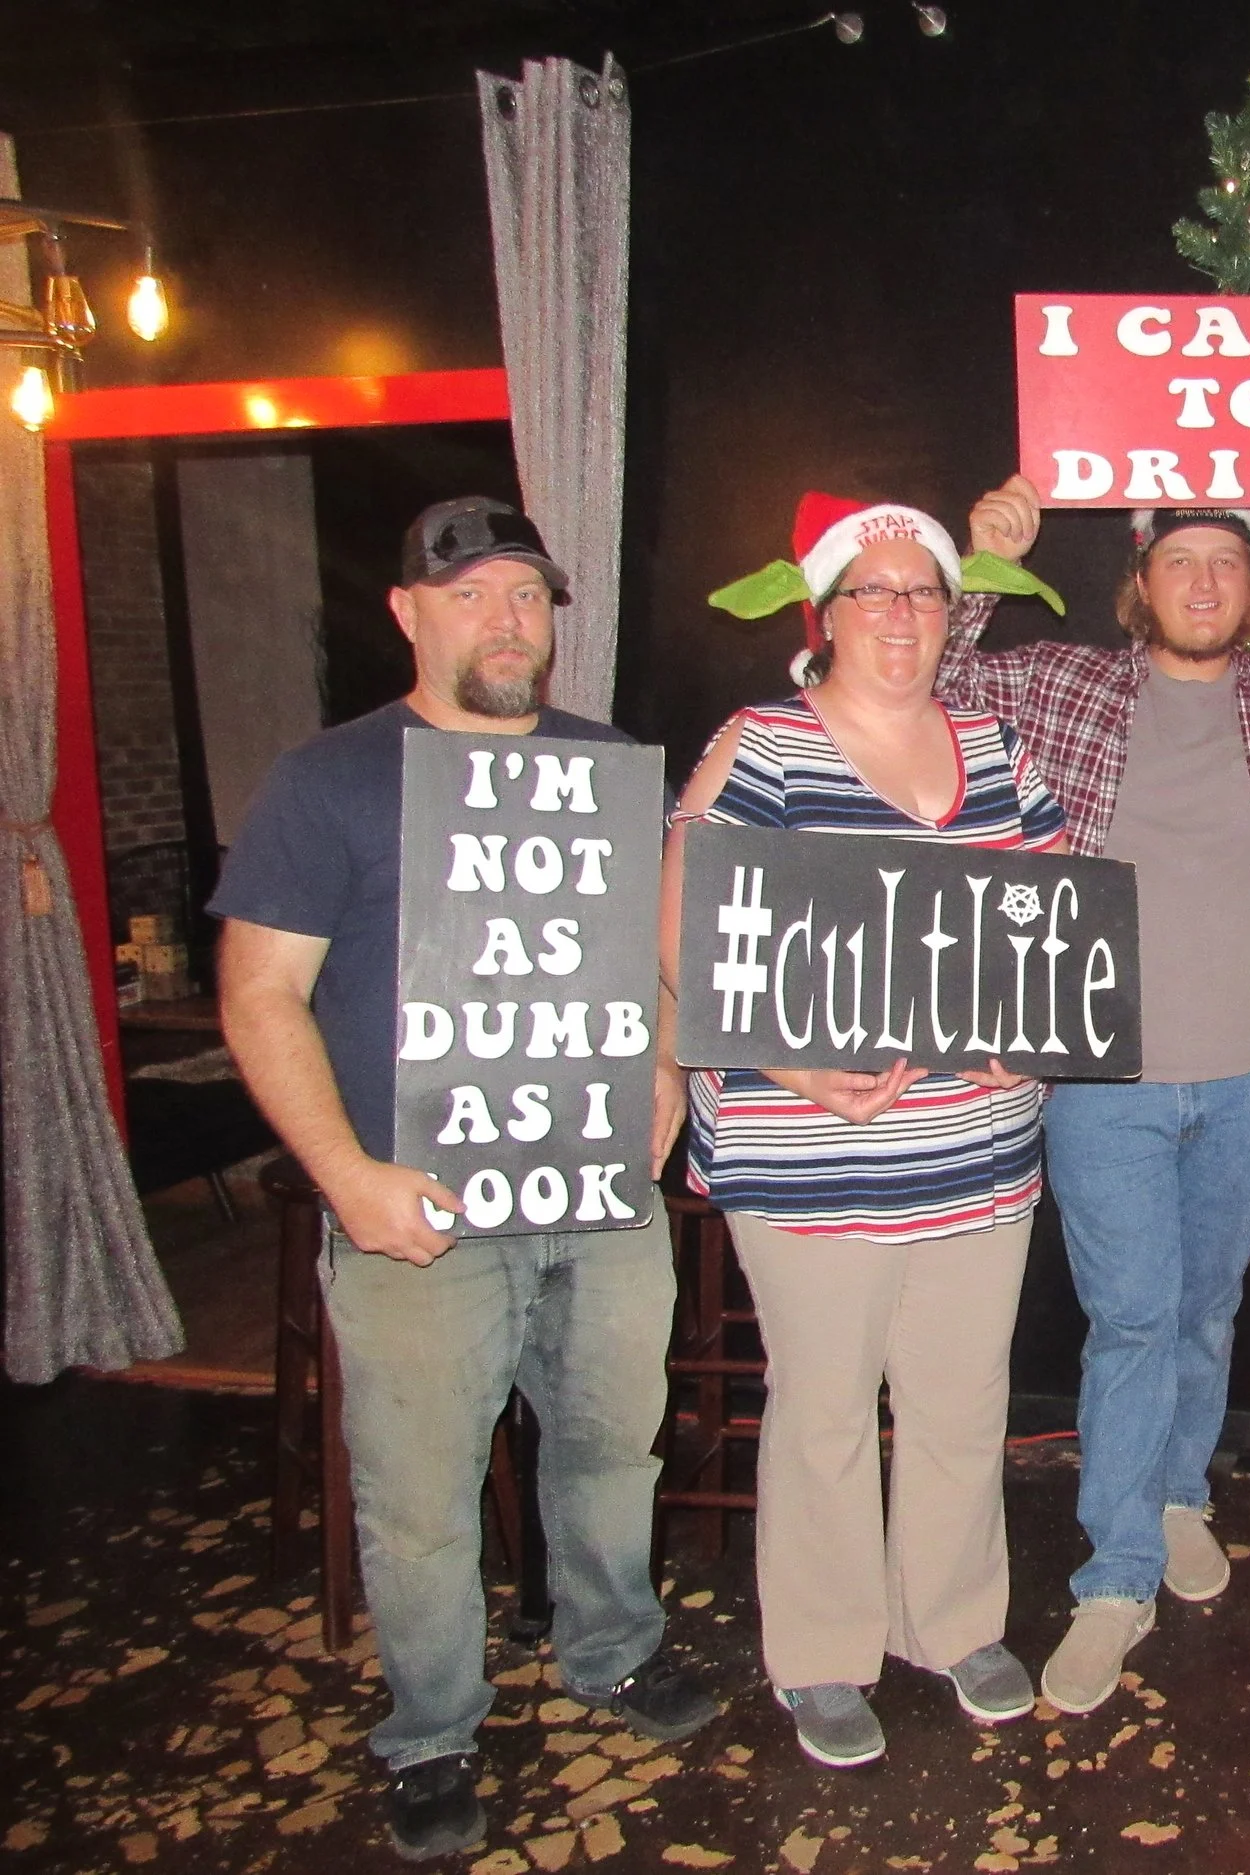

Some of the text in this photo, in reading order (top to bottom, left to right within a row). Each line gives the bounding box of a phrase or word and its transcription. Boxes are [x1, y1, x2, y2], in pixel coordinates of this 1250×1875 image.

[1039, 306, 1079, 356] I
[464, 751, 598, 813] I'M
[447, 833, 613, 895] NOT
[472, 917, 584, 976] AS
[399, 1001, 651, 1060] DUMB
[437, 1082, 614, 1145] AS I
